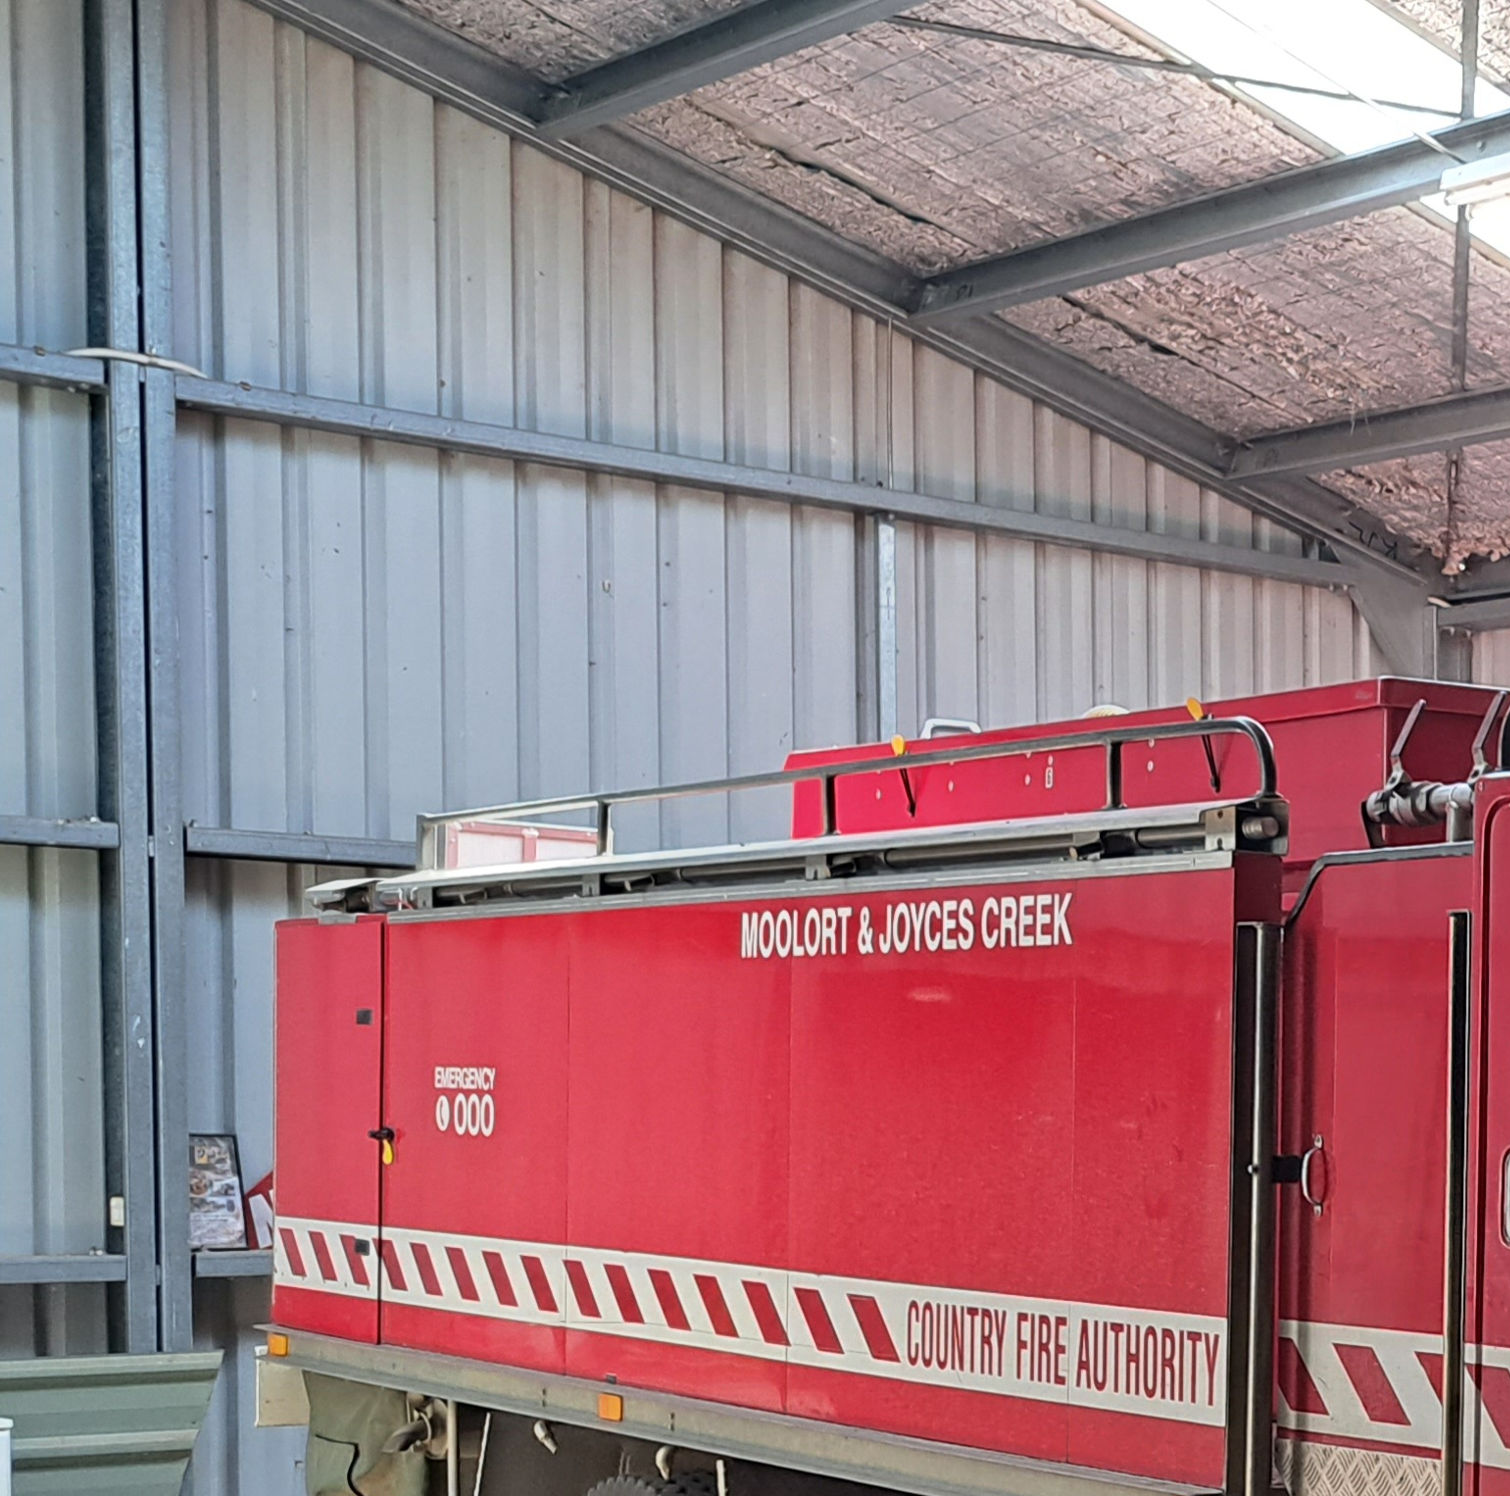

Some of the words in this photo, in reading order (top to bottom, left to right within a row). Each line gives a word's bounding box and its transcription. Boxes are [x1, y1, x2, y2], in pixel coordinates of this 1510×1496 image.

[741, 906, 852, 959] MOOLORT
[857, 906, 874, 955] &
[879, 898, 975, 955] JOYCES
[980, 892, 1073, 949] CREEK
[434, 1066, 496, 1091] EMERGENCY
[454, 1092, 495, 1137] 000
[907, 1299, 1008, 1378] COUNTRY
[1016, 1311, 1068, 1387] FIRE
[1075, 1318, 1220, 1407] AUTHORITY
